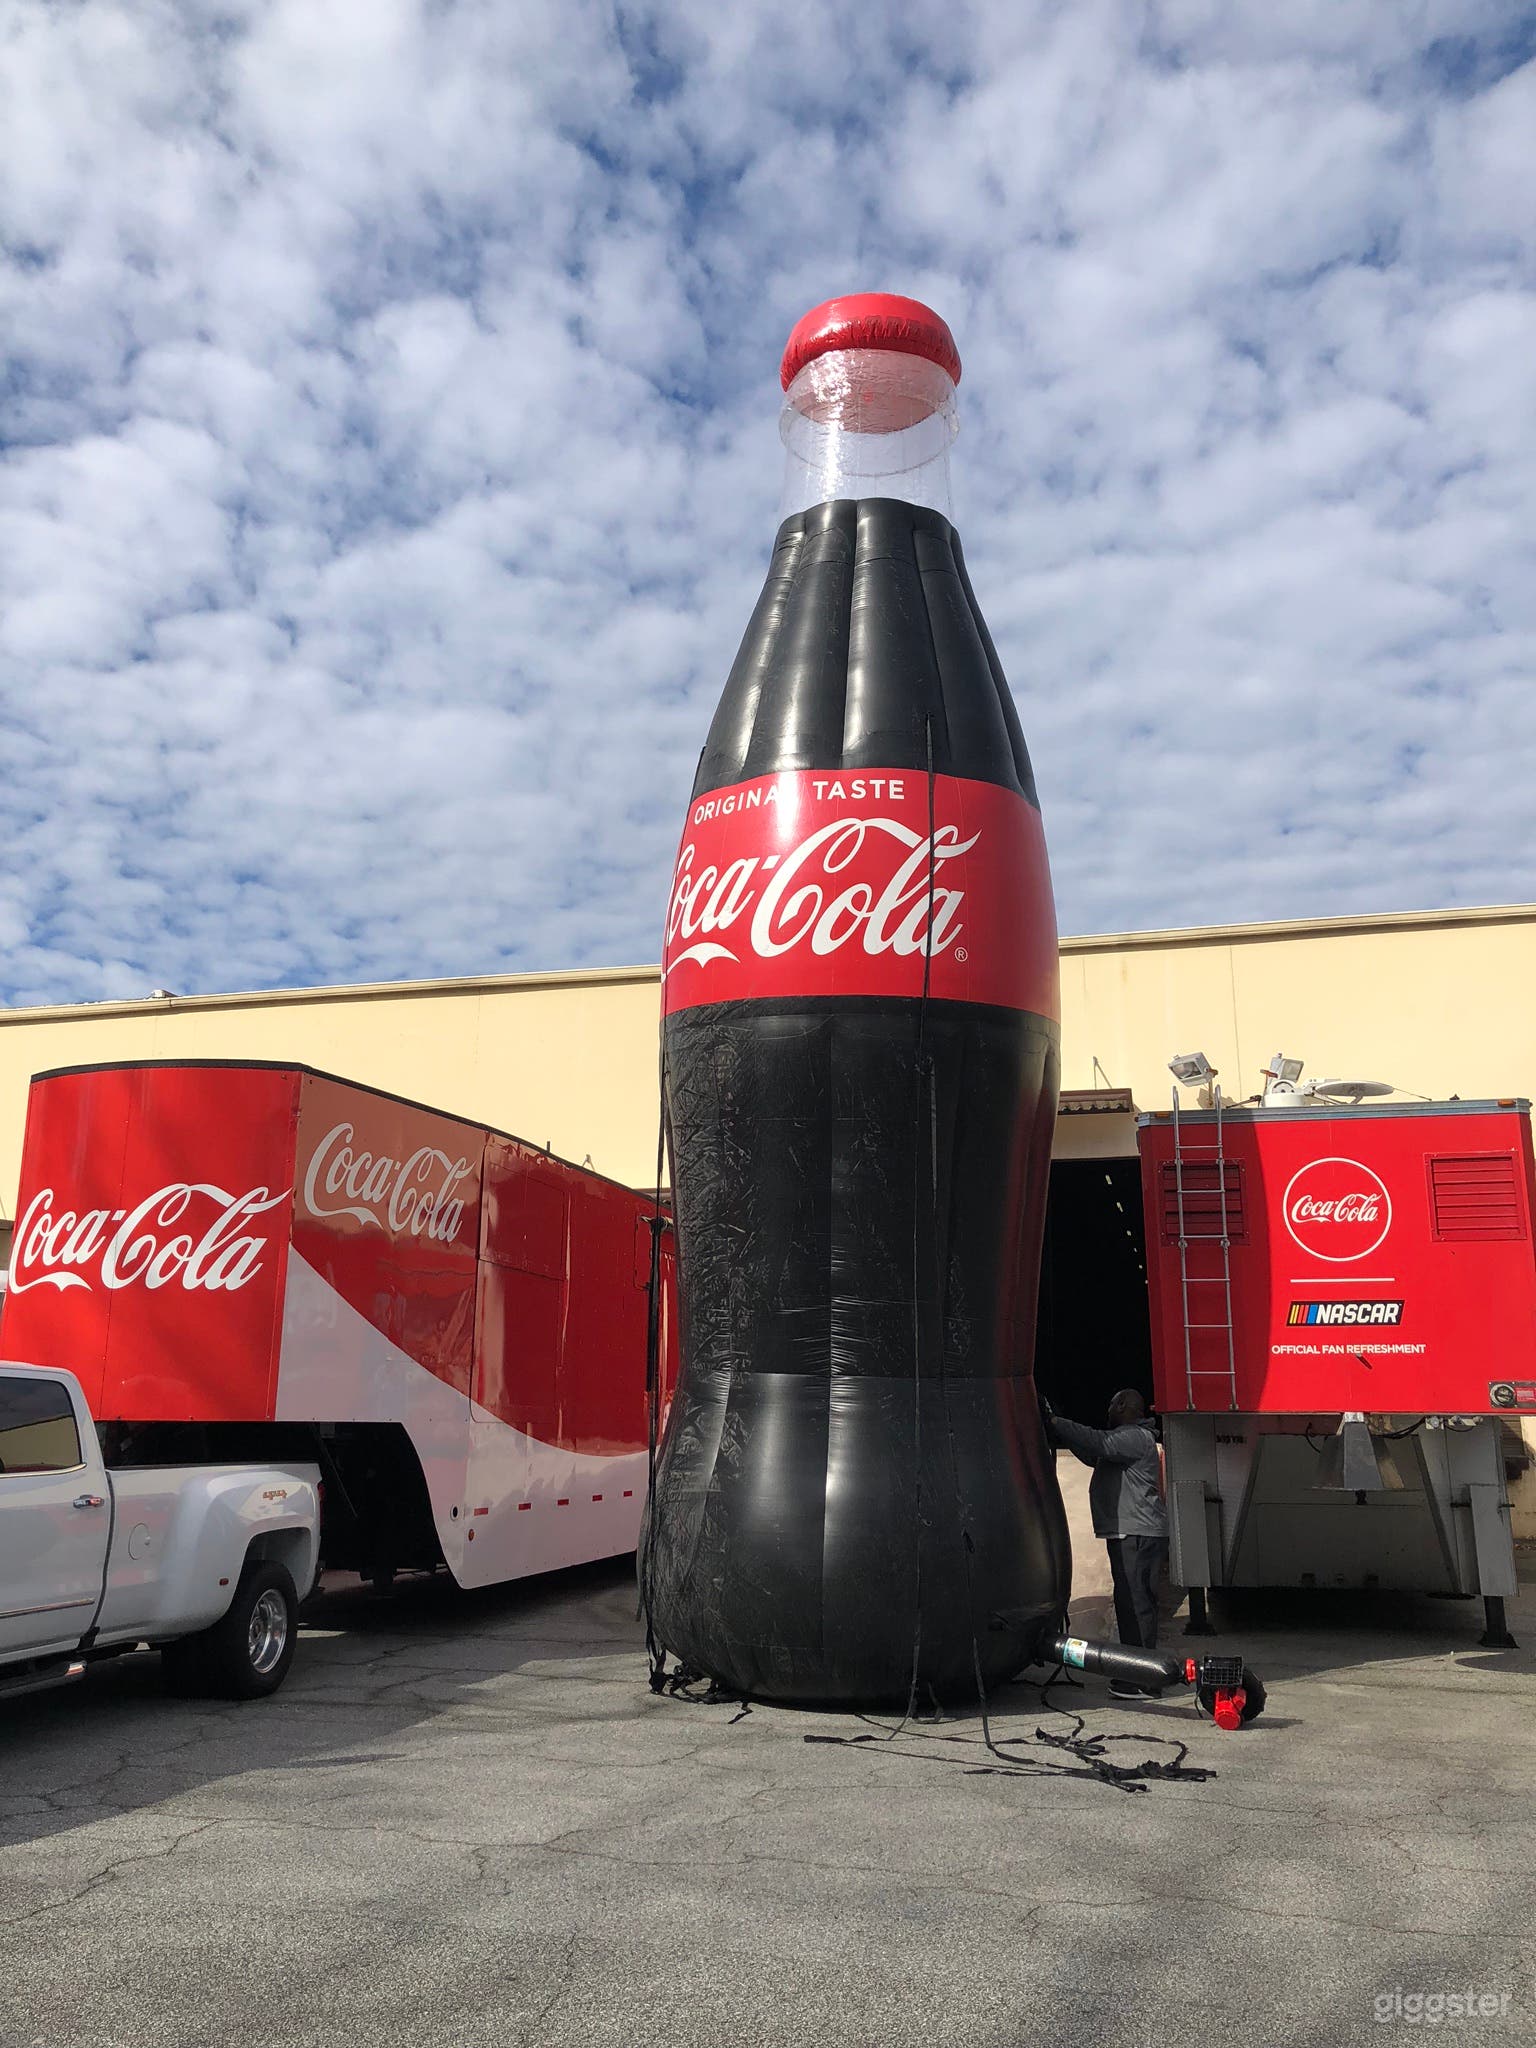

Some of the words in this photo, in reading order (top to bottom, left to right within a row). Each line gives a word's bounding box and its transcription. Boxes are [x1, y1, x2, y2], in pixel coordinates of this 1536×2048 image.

[694, 784, 788, 824] ORIGINA
[812, 779, 905, 800] TASTE
[661, 817, 982, 976] Coca-Cola
[303, 1122, 477, 1242] Coca-Cola
[1291, 1193, 1383, 1224] Coca-Cola
[8, 1183, 293, 1294] Coca-Cola
[1316, 1303, 1400, 1325] NASCAR
[1271, 1345, 1320, 1355] OFFICIAL
[1322, 1344, 1345, 1355] FAN
[1347, 1344, 1427, 1355] REFRESHMENT
